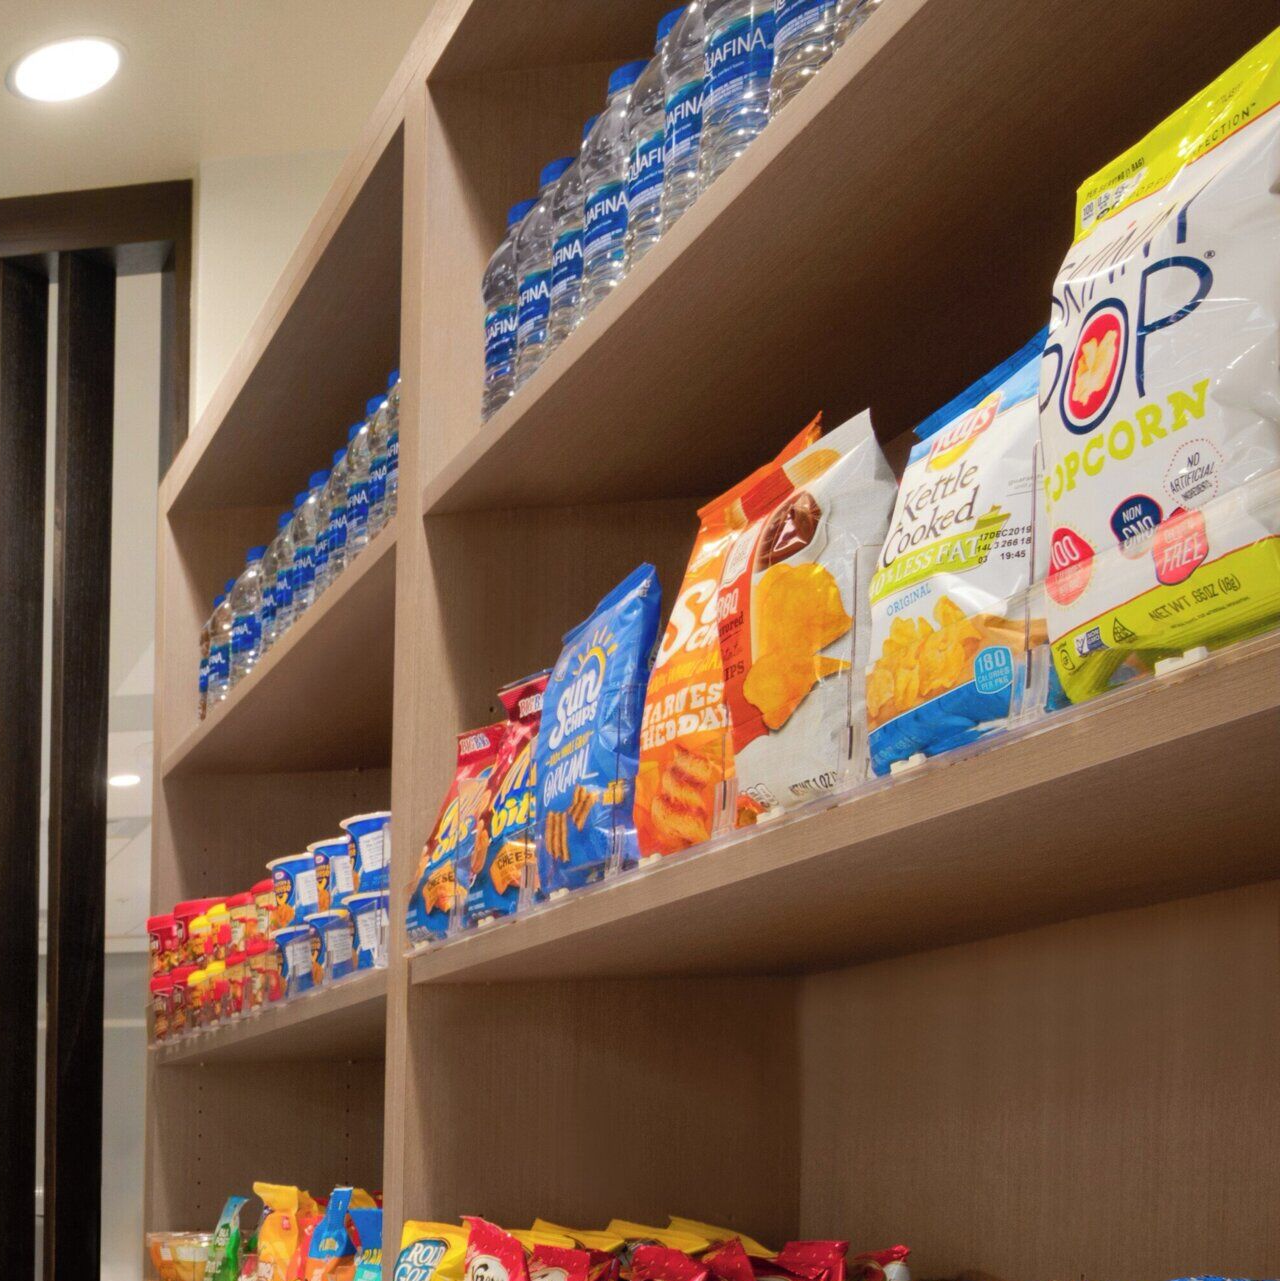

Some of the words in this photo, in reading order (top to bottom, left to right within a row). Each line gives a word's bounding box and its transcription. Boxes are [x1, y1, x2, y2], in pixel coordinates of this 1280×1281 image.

[1186, 451, 1200, 468] NO
[899, 460, 979, 525] Kettle
[1169, 461, 1215, 494] ARTIFICIAL
[882, 485, 981, 570] Cooked
[1122, 503, 1142, 522] NON
[999, 549, 1027, 561] 19:45
[1001, 537, 1018, 549] 266
[1020, 536, 1032, 546] 18
[1051, 535, 1080, 570] 100
[1160, 537, 1205, 576] FREE
[894, 544, 934, 585] LESS
[886, 583, 932, 618] ORIGINAL
[1148, 606, 1170, 622] NET
[1170, 599, 1192, 615] WT
[976, 665, 1010, 684] CALORIES
[977, 647, 1006, 673] 180
[564, 700, 598, 741] CHIPS
